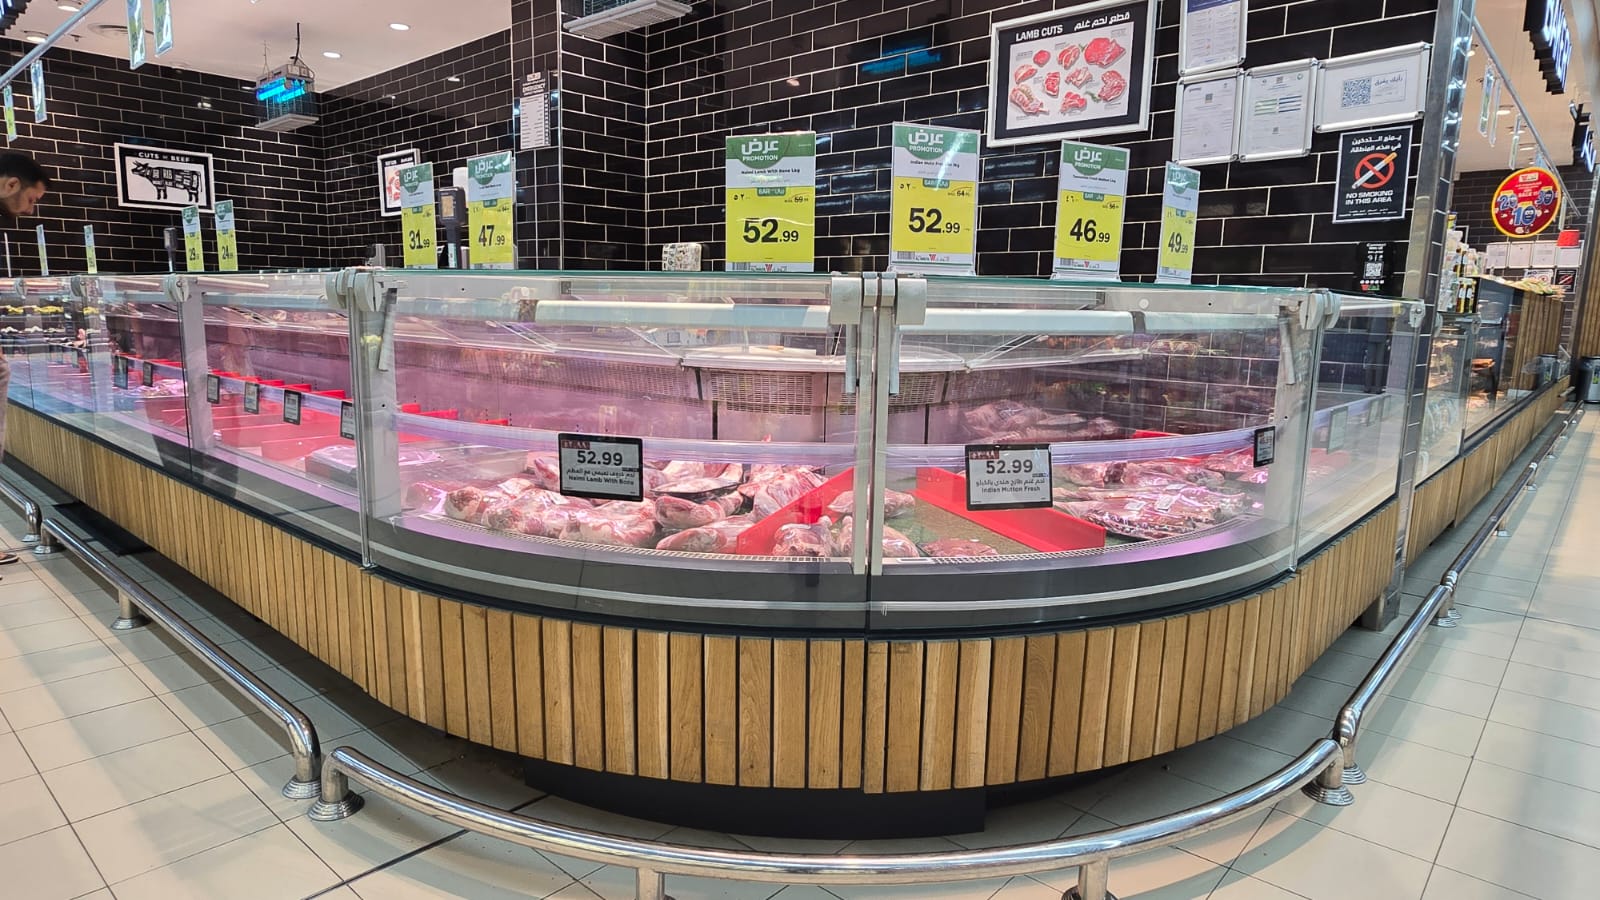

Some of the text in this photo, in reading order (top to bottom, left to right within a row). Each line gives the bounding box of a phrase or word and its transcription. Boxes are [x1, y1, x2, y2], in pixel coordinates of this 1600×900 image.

[1091, 16, 1108, 28] لحم
[1109, 12, 1130, 25] قطع
[1016, 25, 1064, 42] LAMB CUTS
[908, 129, 944, 145] عرض
[741, 138, 779, 155] عرض
[1074, 147, 1102, 162] عرض
[1350, 145, 1375, 153] المنطقة
[1391, 142, 1401, 151] في
[475, 160, 493, 174] عرض
[1075, 162, 1102, 170] PROMOTION
[1358, 190, 1393, 198] SMOKING
[908, 208, 961, 233] 52.99
[1512, 206, 1536, 226] 10
[478, 225, 505, 247] 47.99
[743, 218, 799, 243] 52.99
[1070, 218, 1110, 243] 46.99
[1168, 232, 1189, 254] 49.99
[577, 450, 623, 466] 52.99
[986, 459, 1033, 474] 52.99
